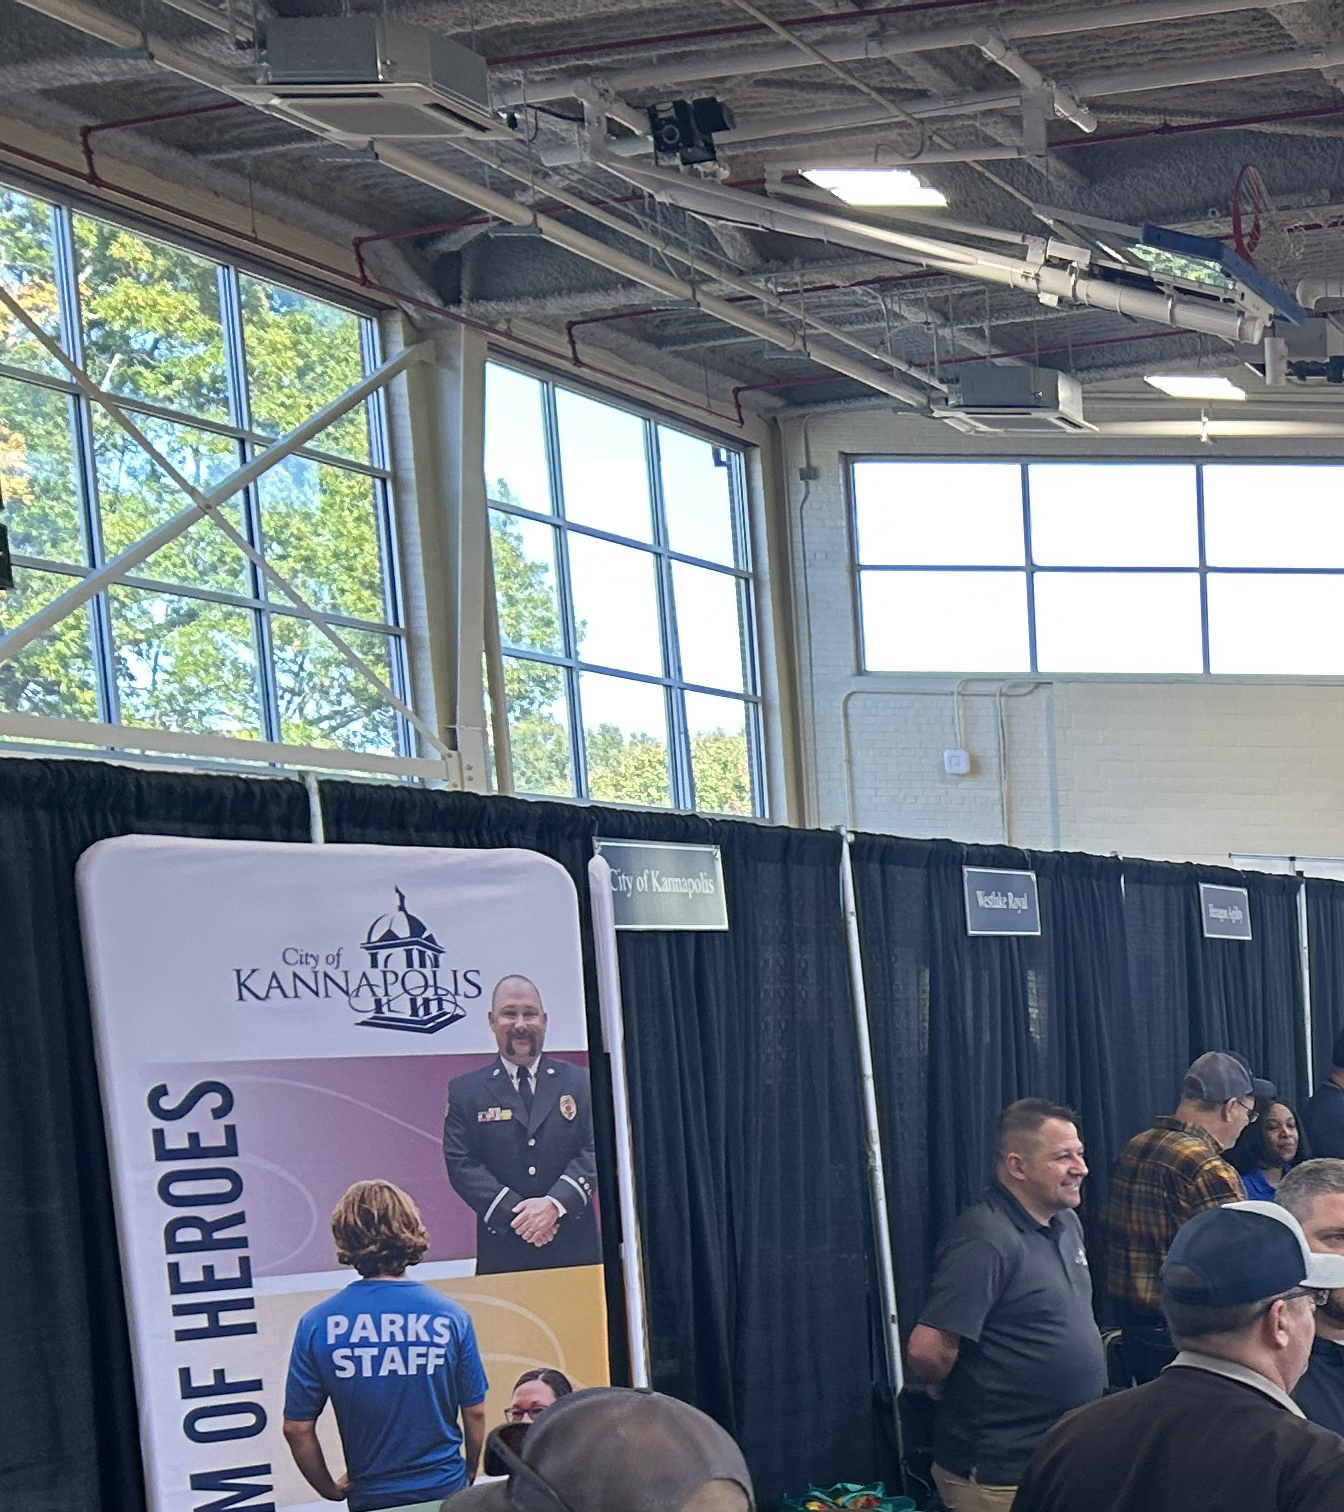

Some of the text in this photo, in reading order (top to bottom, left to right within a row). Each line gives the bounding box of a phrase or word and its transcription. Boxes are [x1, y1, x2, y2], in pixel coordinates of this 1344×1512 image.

[610, 868, 715, 899] City of Kannapolis
[282, 946, 344, 969] City of
[233, 968, 482, 1002] KANNAPOLIS
[146, 1079, 260, 1342] HEROES
[326, 1312, 452, 1346] PARKS
[331, 1347, 446, 1378] STAFF
[178, 1366, 268, 1444] OF
